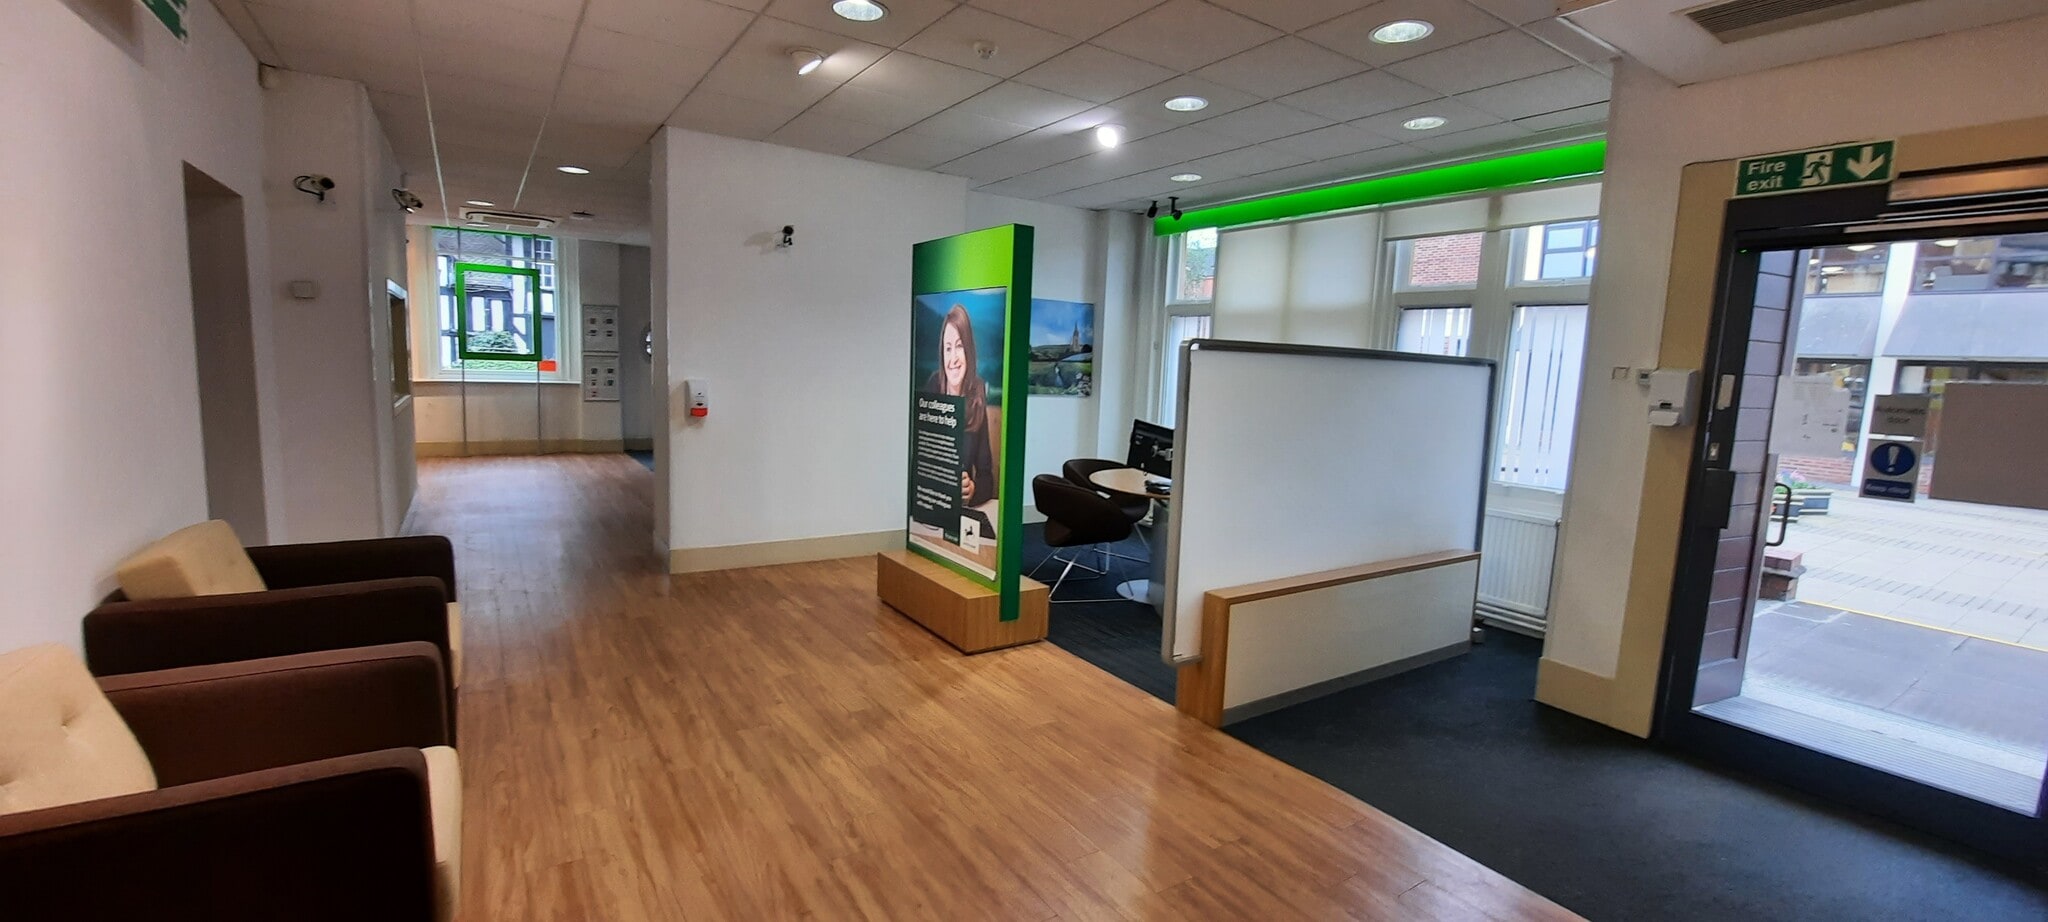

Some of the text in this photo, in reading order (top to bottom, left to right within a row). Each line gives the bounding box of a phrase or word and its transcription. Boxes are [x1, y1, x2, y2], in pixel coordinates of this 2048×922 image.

[1747, 160, 1787, 175] Fire
[1747, 176, 1784, 191] exit
[918, 398, 956, 413] Our colleagues
[926, 412, 938, 423] here
[938, 415, 945, 424] to
[945, 415, 957, 428] help
